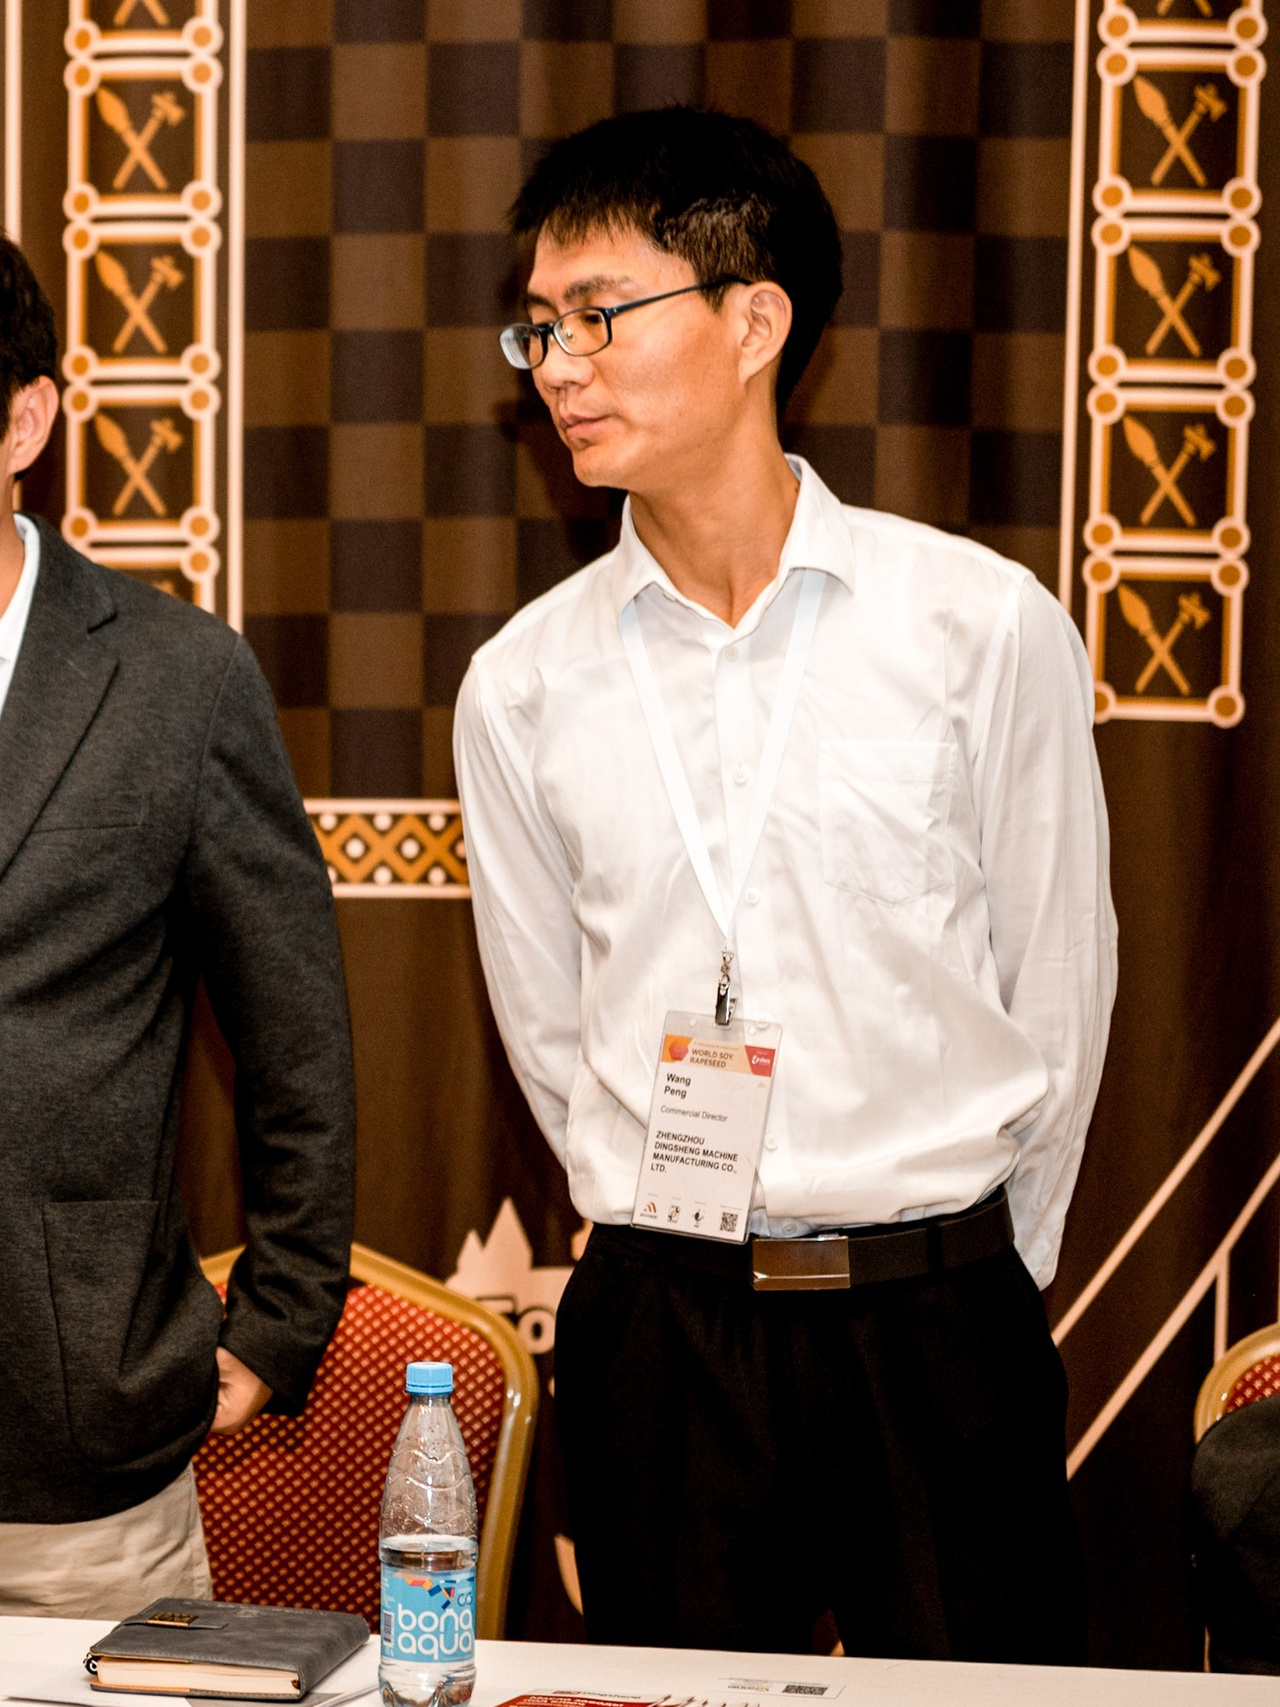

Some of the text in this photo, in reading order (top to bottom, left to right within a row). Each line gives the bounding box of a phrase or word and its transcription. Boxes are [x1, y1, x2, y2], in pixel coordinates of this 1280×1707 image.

[692, 1048, 718, 1058] WORLD
[690, 1057, 726, 1069] RAPESEED
[666, 1073, 691, 1087] Wang
[664, 1085, 687, 1099] Peng
[660, 1105, 728, 1122] Commercial Director
[656, 1130, 705, 1146] ZHENGZHOU
[654, 1141, 739, 1162] DINGSHENG MACHINE
[650, 1163, 667, 1173] LTD.
[652, 1152, 719, 1170] MANUFACTURING
[398, 1603, 472, 1632] bona
[397, 1631, 472, 1660] aqua
